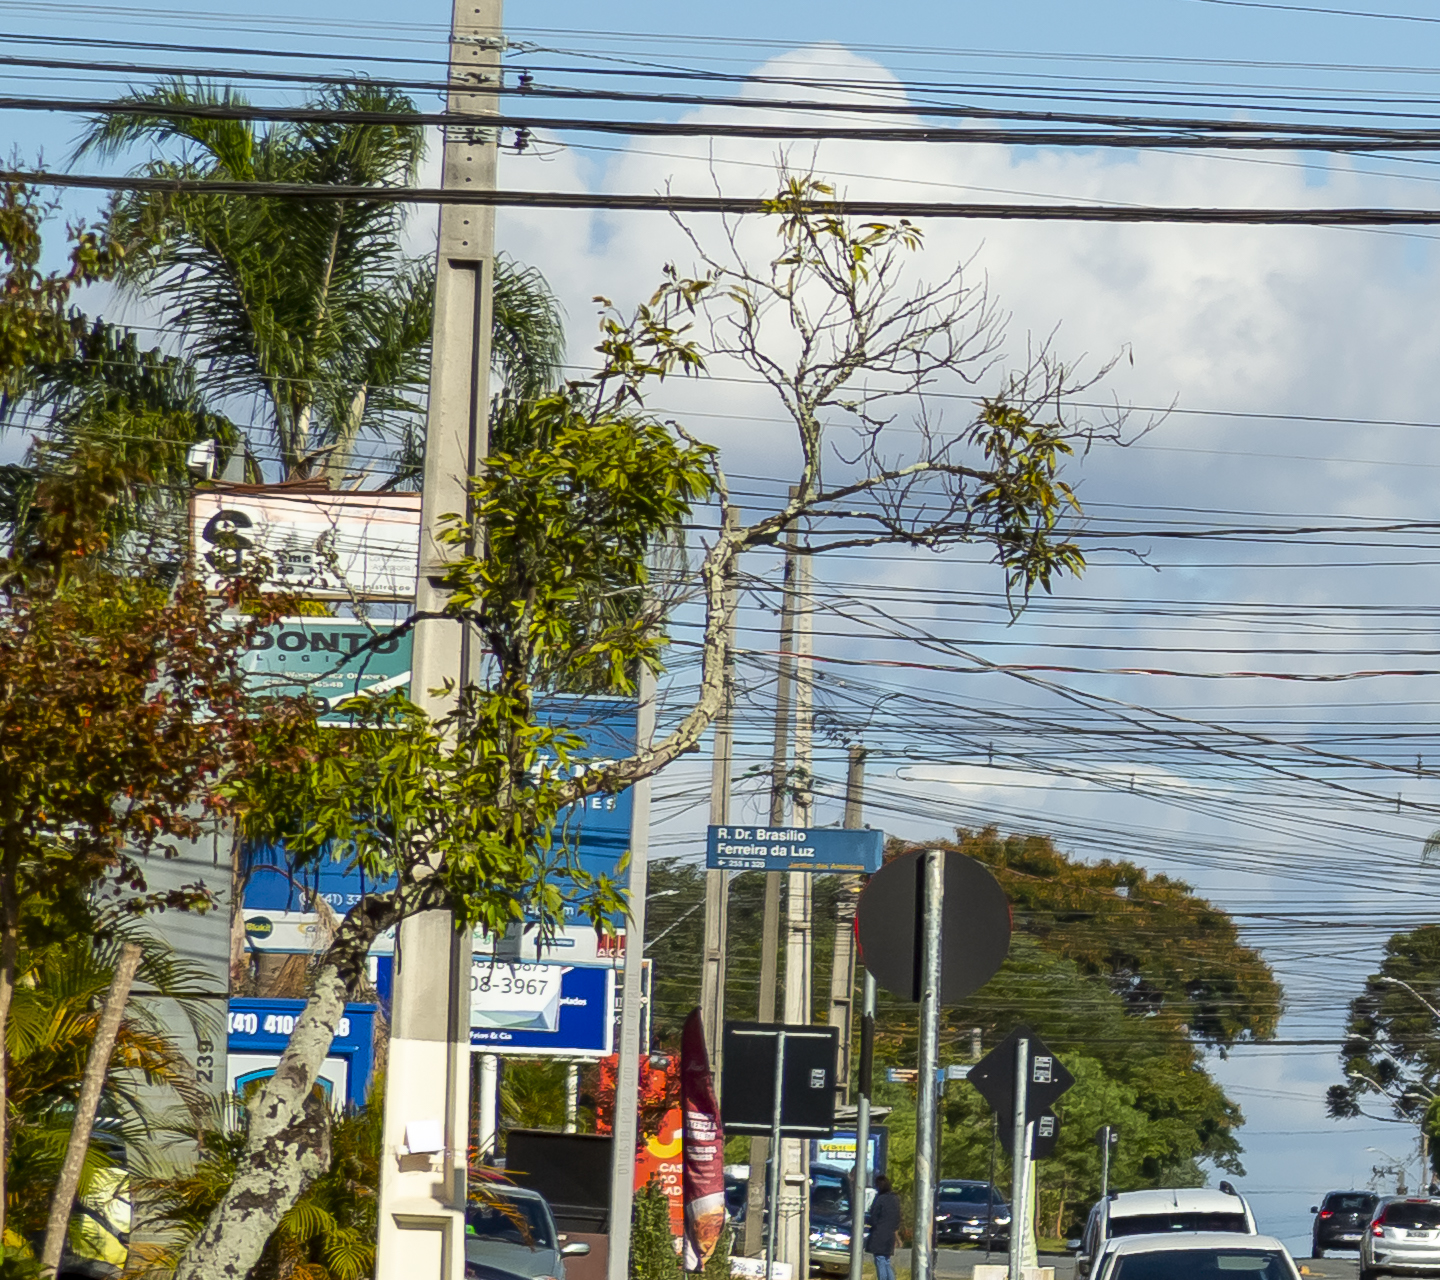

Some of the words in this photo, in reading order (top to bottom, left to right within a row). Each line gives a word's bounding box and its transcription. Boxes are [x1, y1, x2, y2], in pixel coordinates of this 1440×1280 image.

[717, 827, 731, 839] R.
[735, 829, 752, 840] Dr.
[756, 829, 807, 842] Brasílio
[717, 843, 767, 856] Ferreira
[770, 845, 787, 857] da
[790, 845, 815, 858] Luz
[228, 1012, 258, 1035] (41)
[196, 1040, 214, 1083] 239
